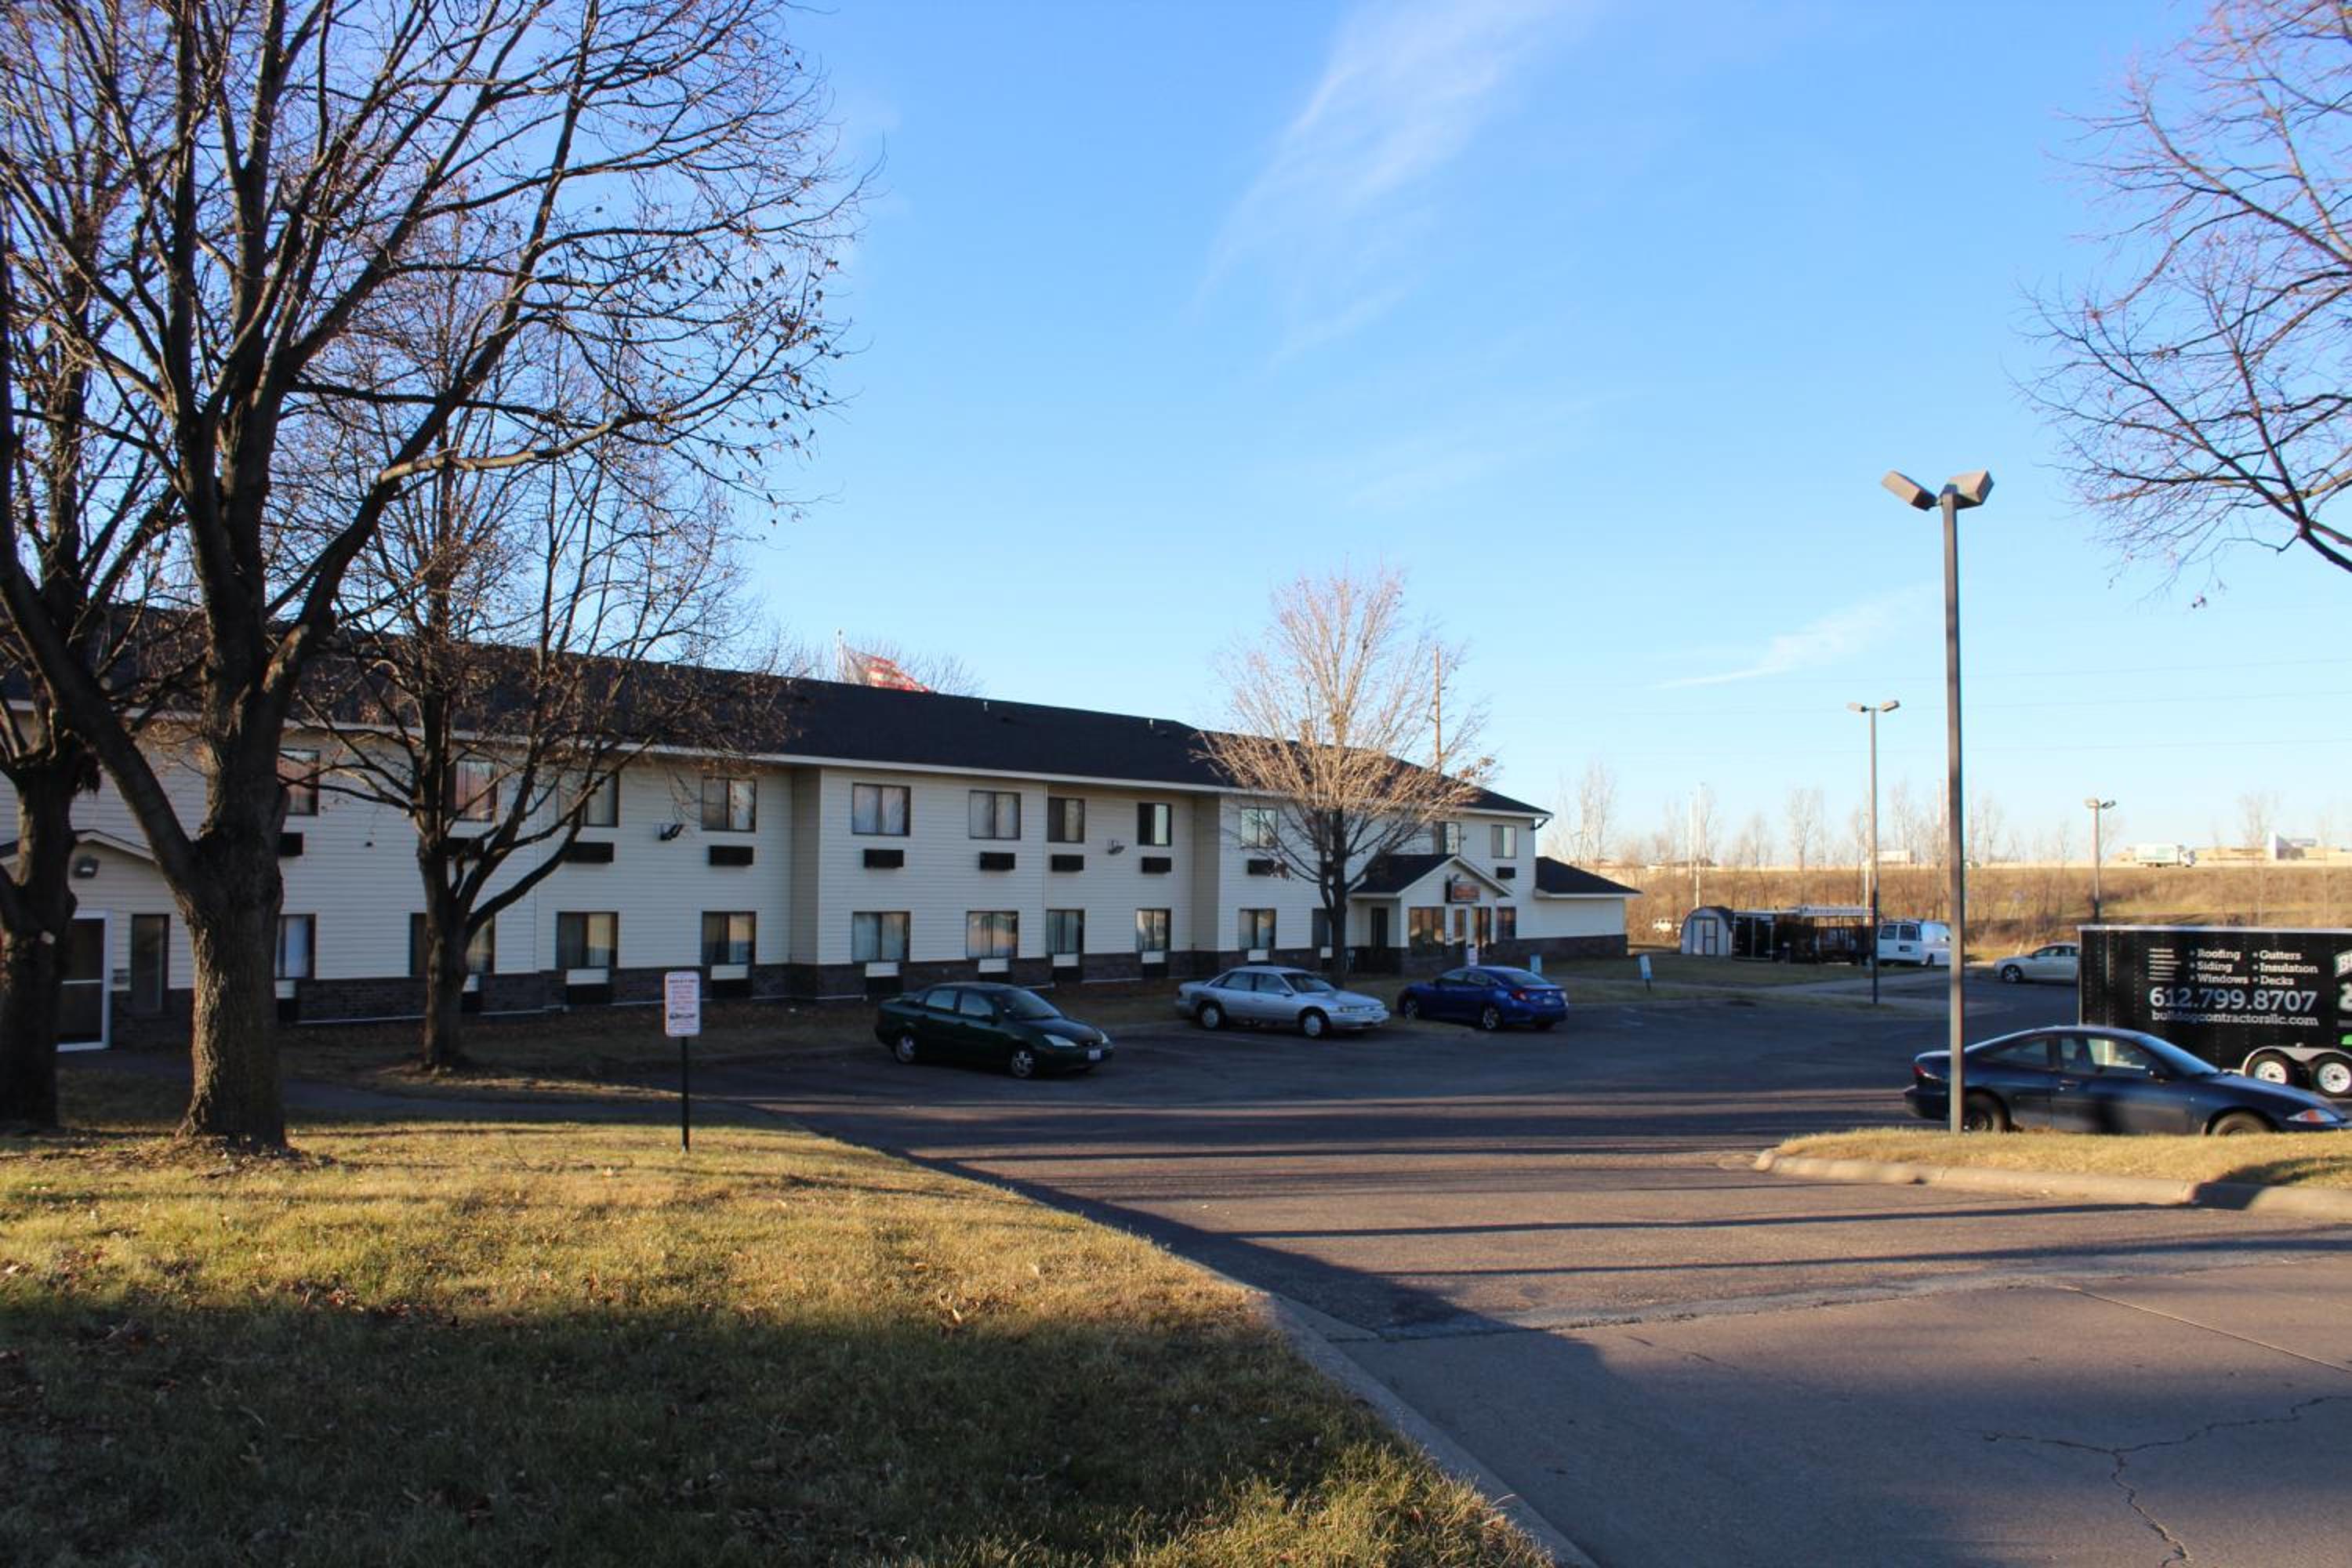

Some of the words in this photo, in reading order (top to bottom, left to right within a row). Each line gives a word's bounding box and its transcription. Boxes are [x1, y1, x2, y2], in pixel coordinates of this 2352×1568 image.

[2197, 949, 2241, 960] Roofing
[2259, 949, 2302, 960] Gutters
[2197, 961, 2233, 973] Siding
[2259, 963, 2318, 974] Insulation
[2197, 973, 2249, 984] Windows
[2259, 975, 2295, 985] Decks
[2149, 986, 2318, 1011] 612.799.8707
[2151, 1010, 2318, 1025] bulldogcontractorsllc.com
